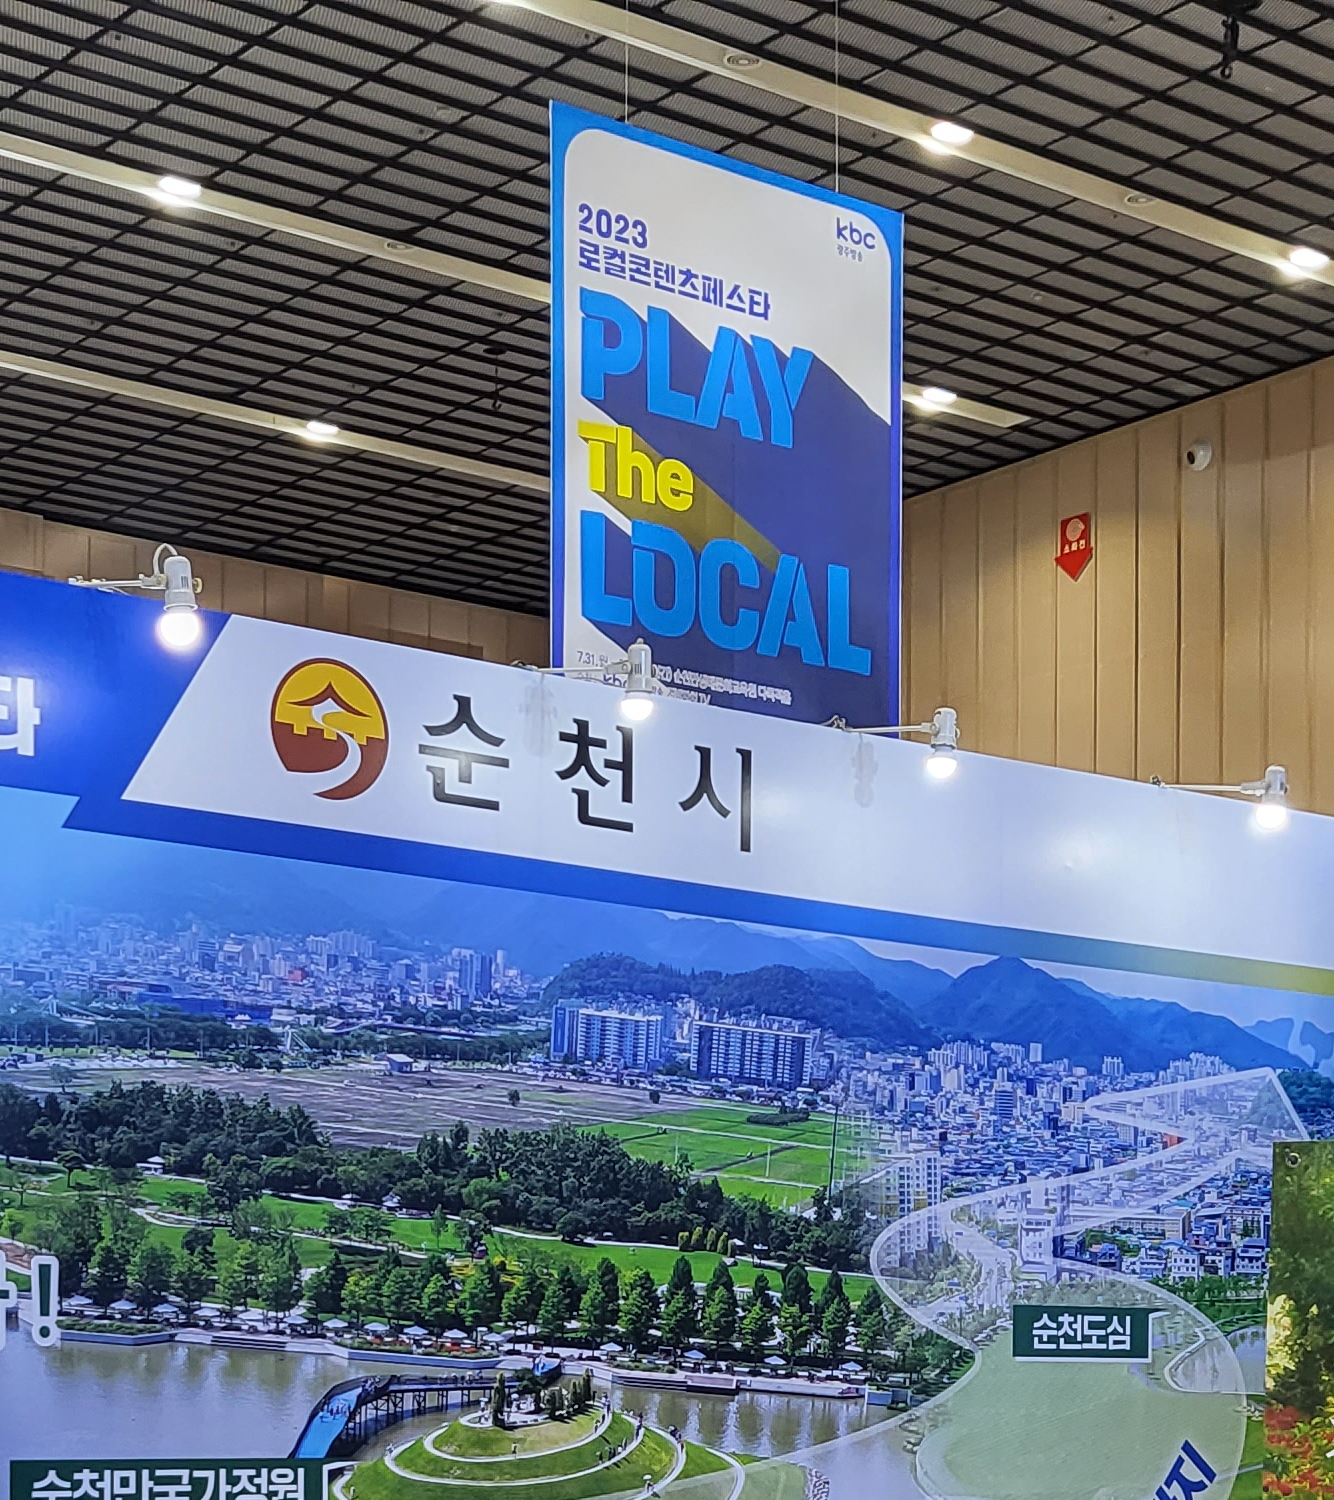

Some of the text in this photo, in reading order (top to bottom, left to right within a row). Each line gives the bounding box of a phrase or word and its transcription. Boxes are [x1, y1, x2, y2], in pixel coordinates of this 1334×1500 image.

[579, 203, 648, 249] 2023
[836, 217, 876, 250] kbc
[579, 239, 771, 321] 로컬콘텐츠페스타
[580, 286, 815, 449] PLAY
[578, 420, 694, 512] The
[580, 510, 872, 677] LOCAL
[1031, 1312, 1132, 1351] 순천도심
